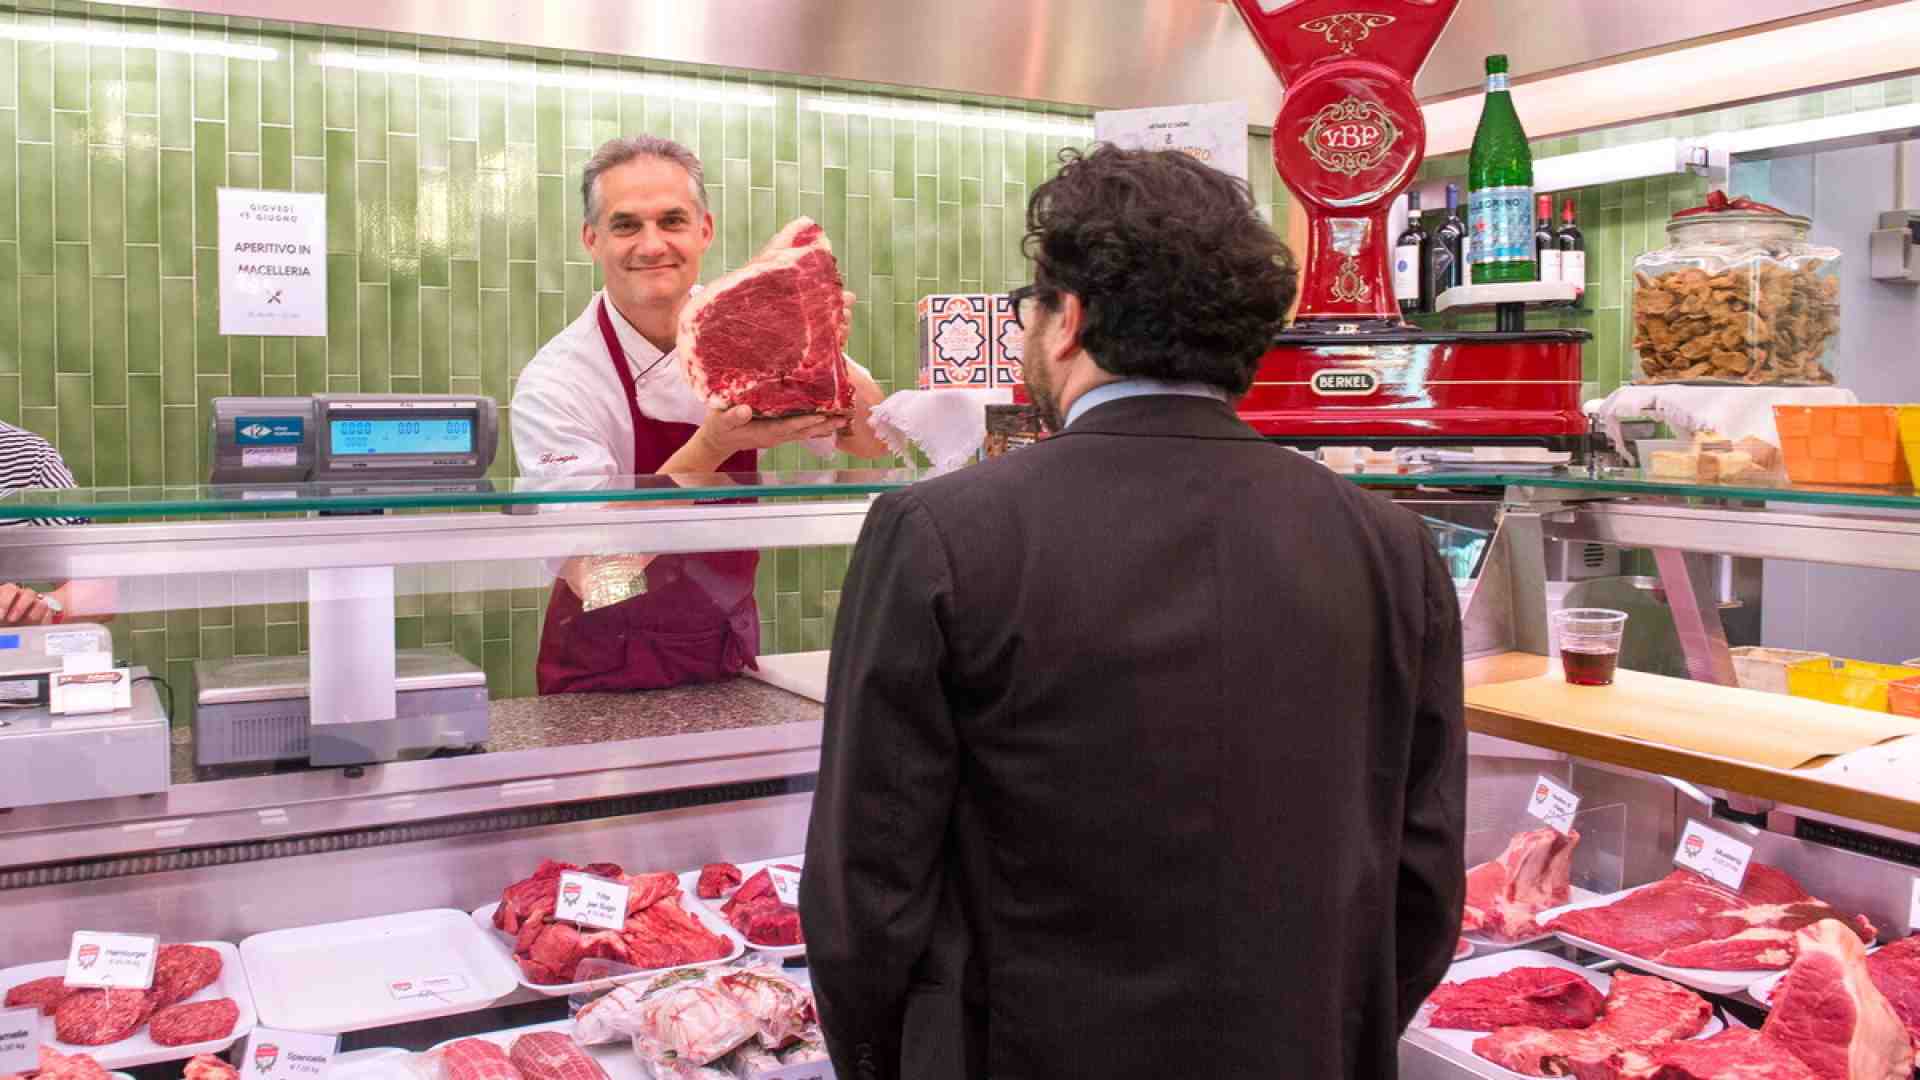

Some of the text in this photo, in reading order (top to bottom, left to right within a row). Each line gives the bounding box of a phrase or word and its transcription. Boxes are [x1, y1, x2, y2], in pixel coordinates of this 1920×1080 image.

[234, 242, 311, 254] APERITIVO IN
[238, 264, 311, 277] MACELLERIA
[1319, 375, 1369, 388] BERKEL
